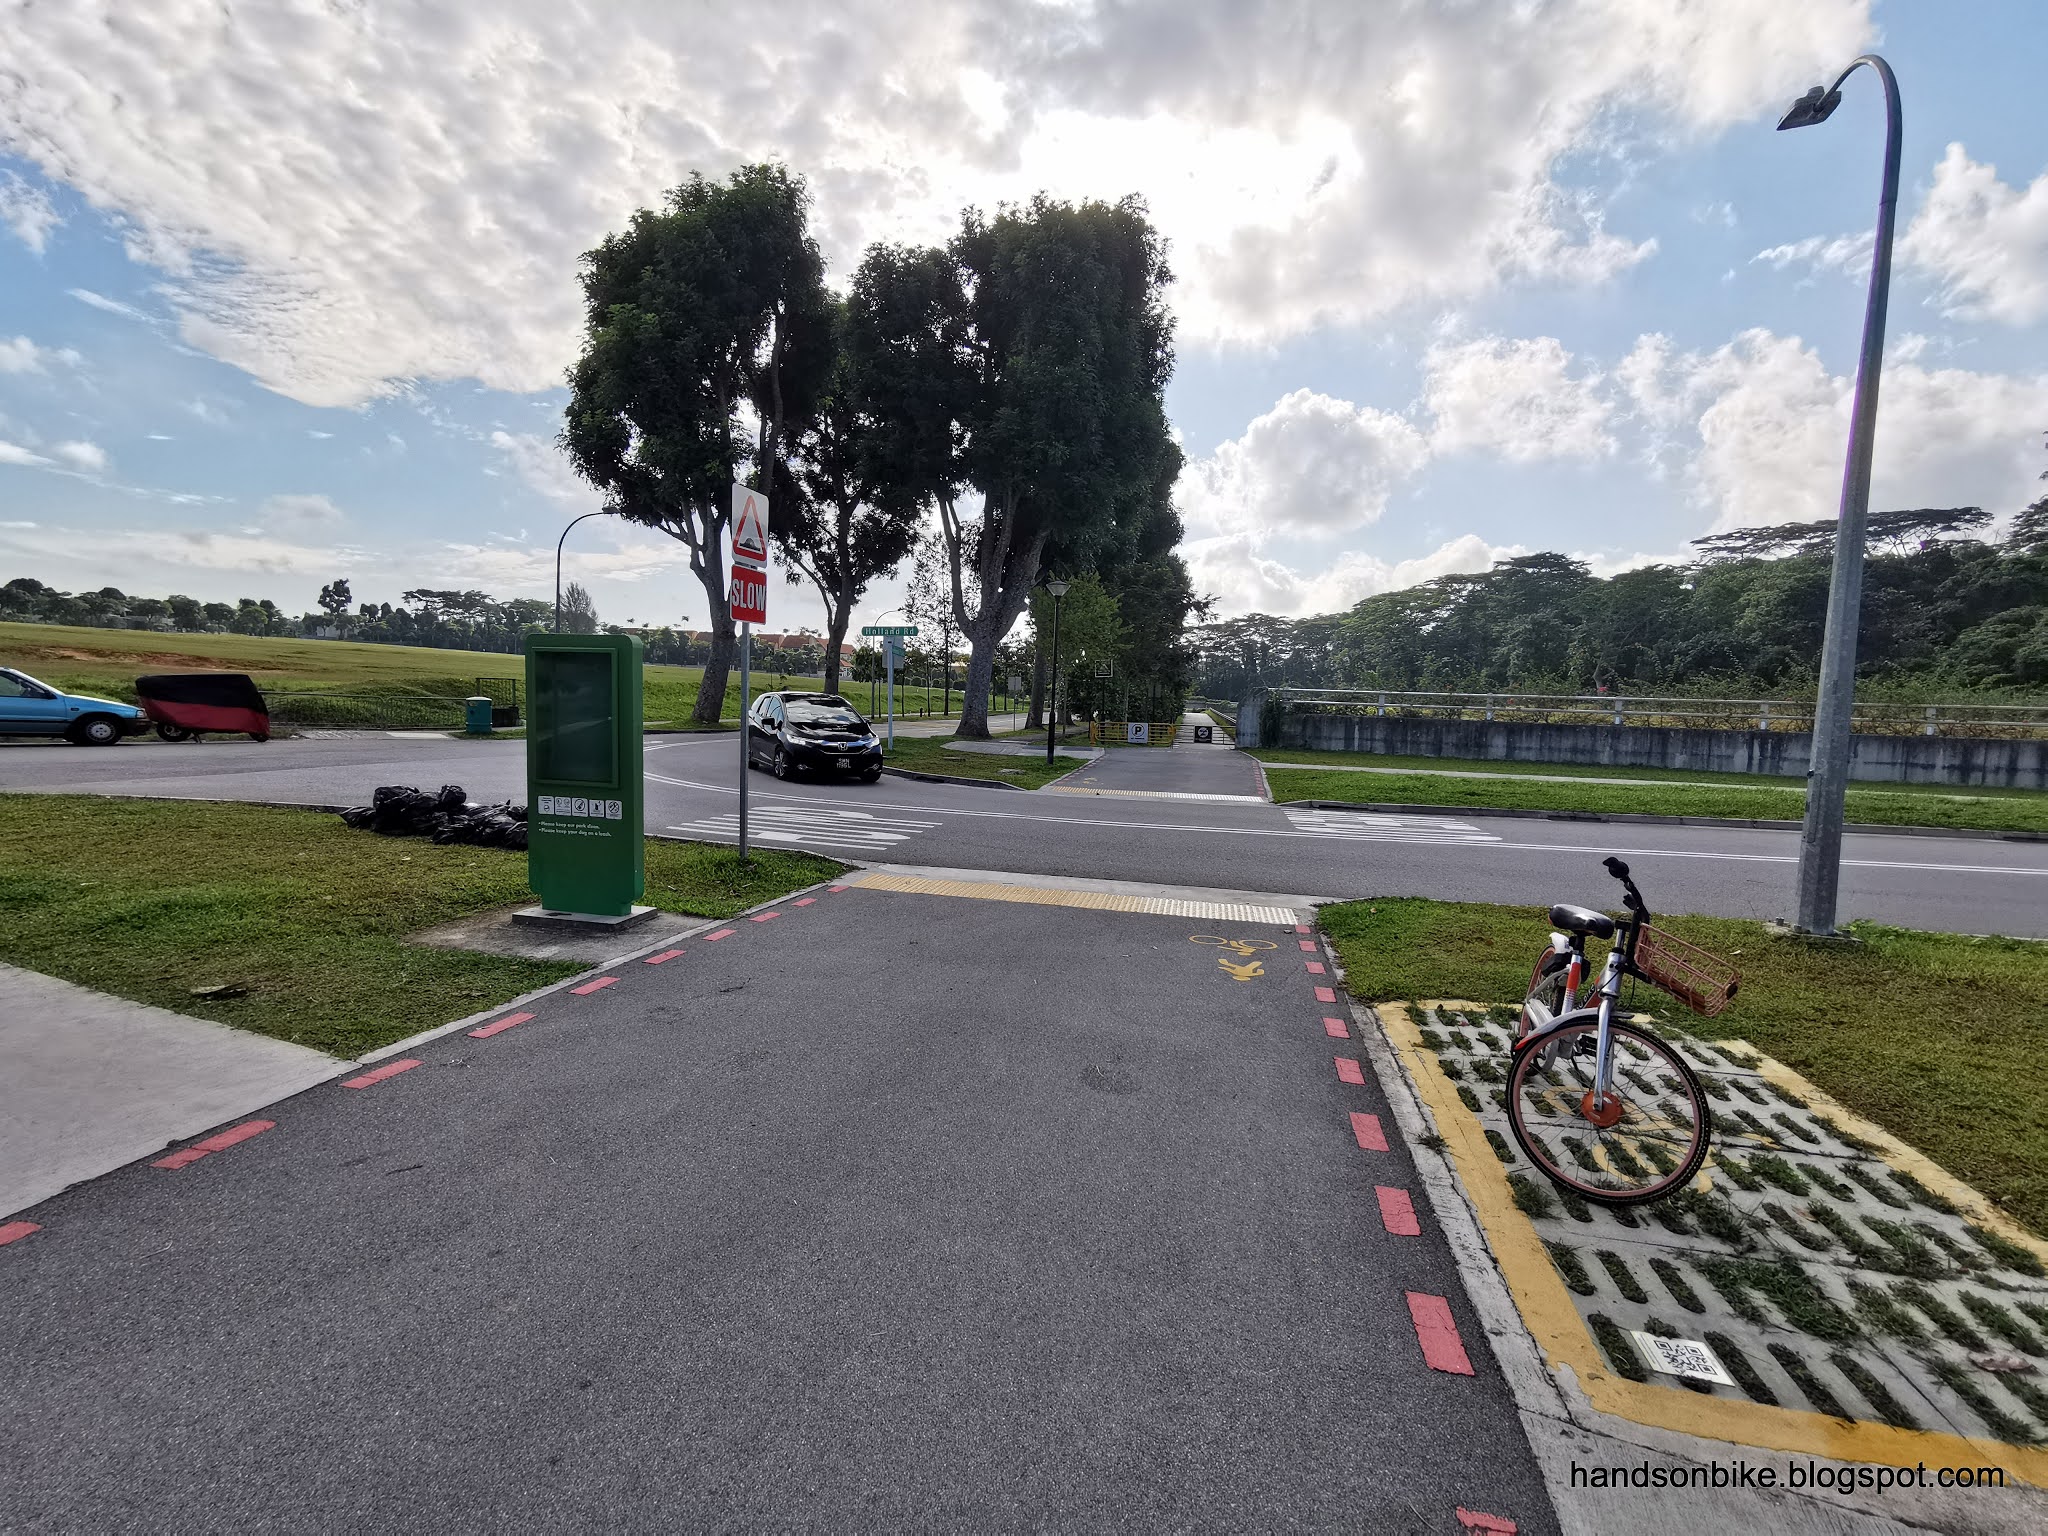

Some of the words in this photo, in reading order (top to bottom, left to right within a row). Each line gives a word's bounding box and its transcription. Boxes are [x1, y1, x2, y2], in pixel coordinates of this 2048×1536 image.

[732, 578, 766, 611] SLOW
[865, 627, 900, 635] Holland
[903, 627, 914, 635] Rd
